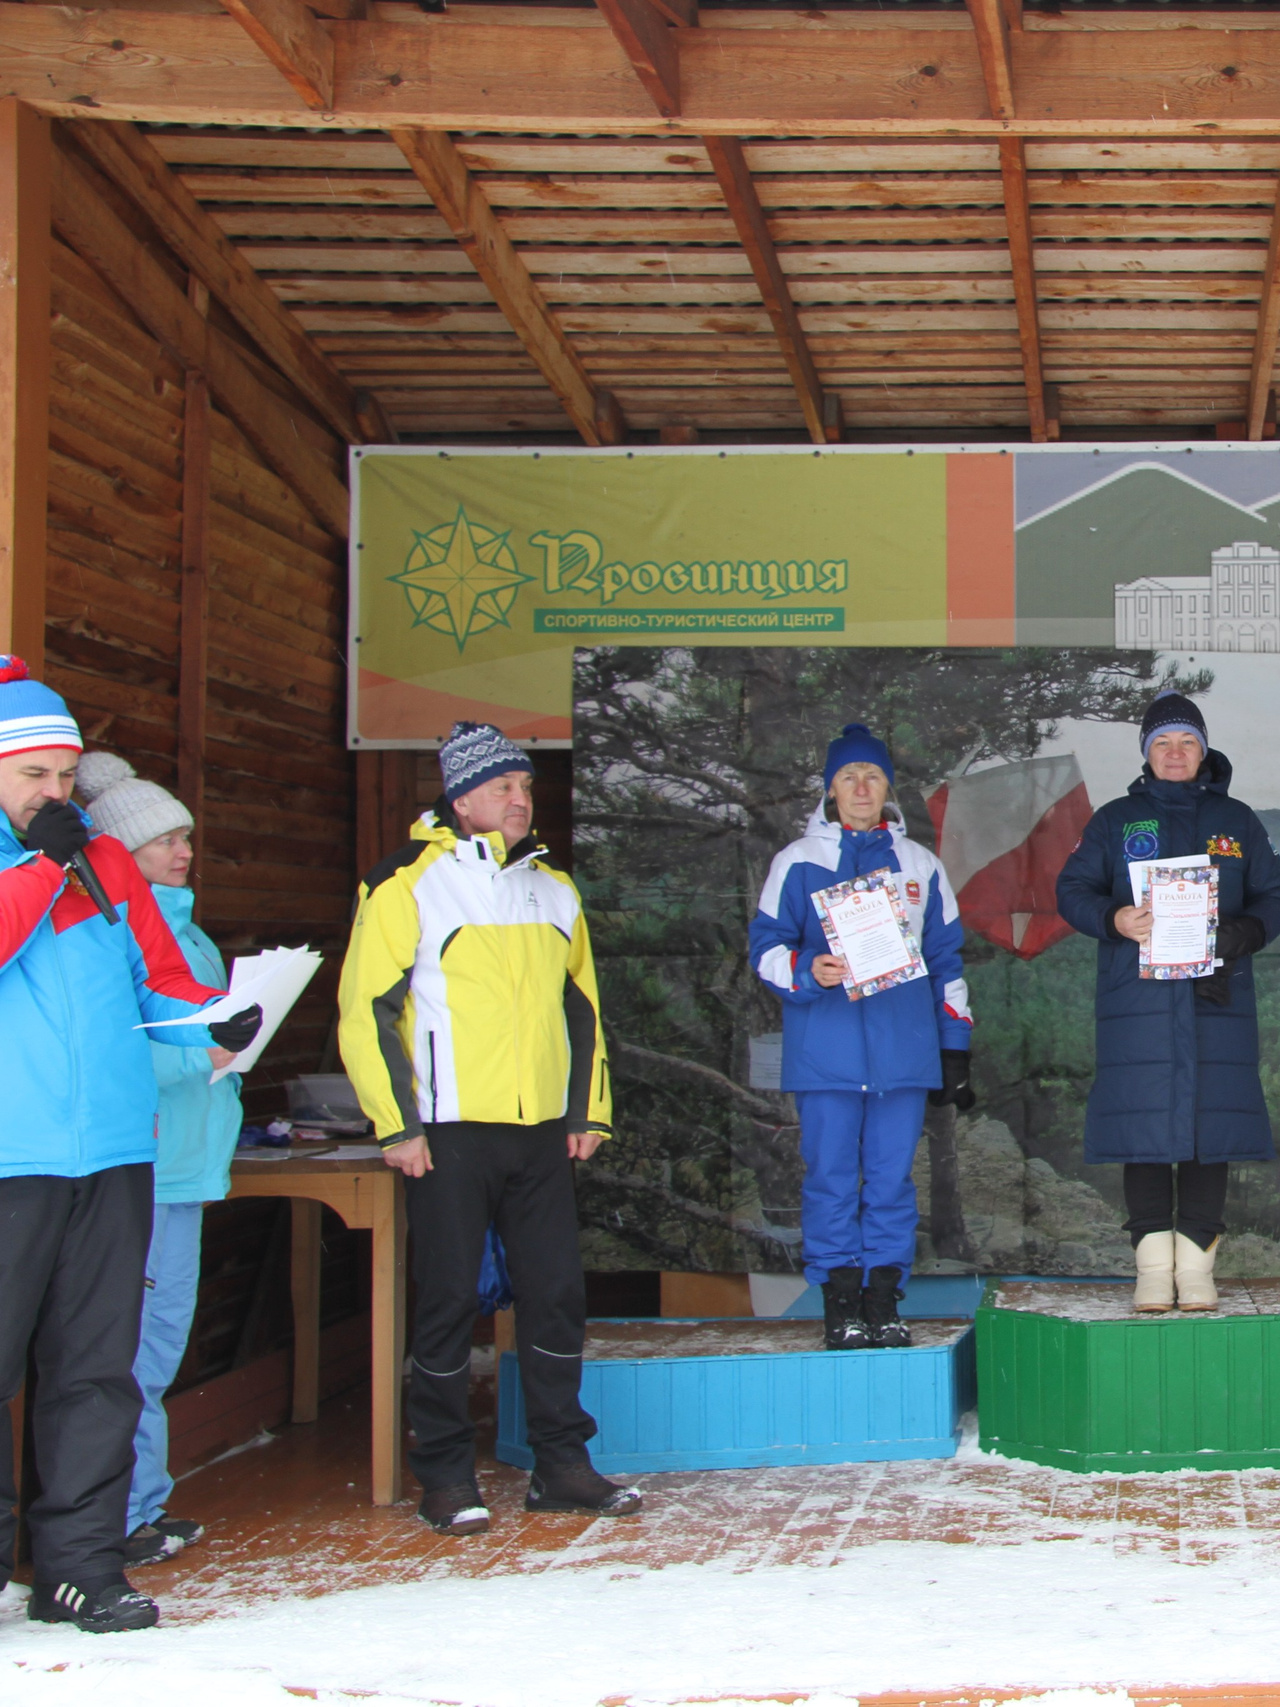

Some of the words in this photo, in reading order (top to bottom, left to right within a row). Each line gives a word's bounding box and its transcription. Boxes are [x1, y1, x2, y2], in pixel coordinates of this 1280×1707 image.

[528, 530, 848, 605] Провинция
[543, 612, 779, 629] СПОРТИВНО-ТУРИСТИЧЕСКИЙ
[782, 612, 835, 628] ЦЕНТР
